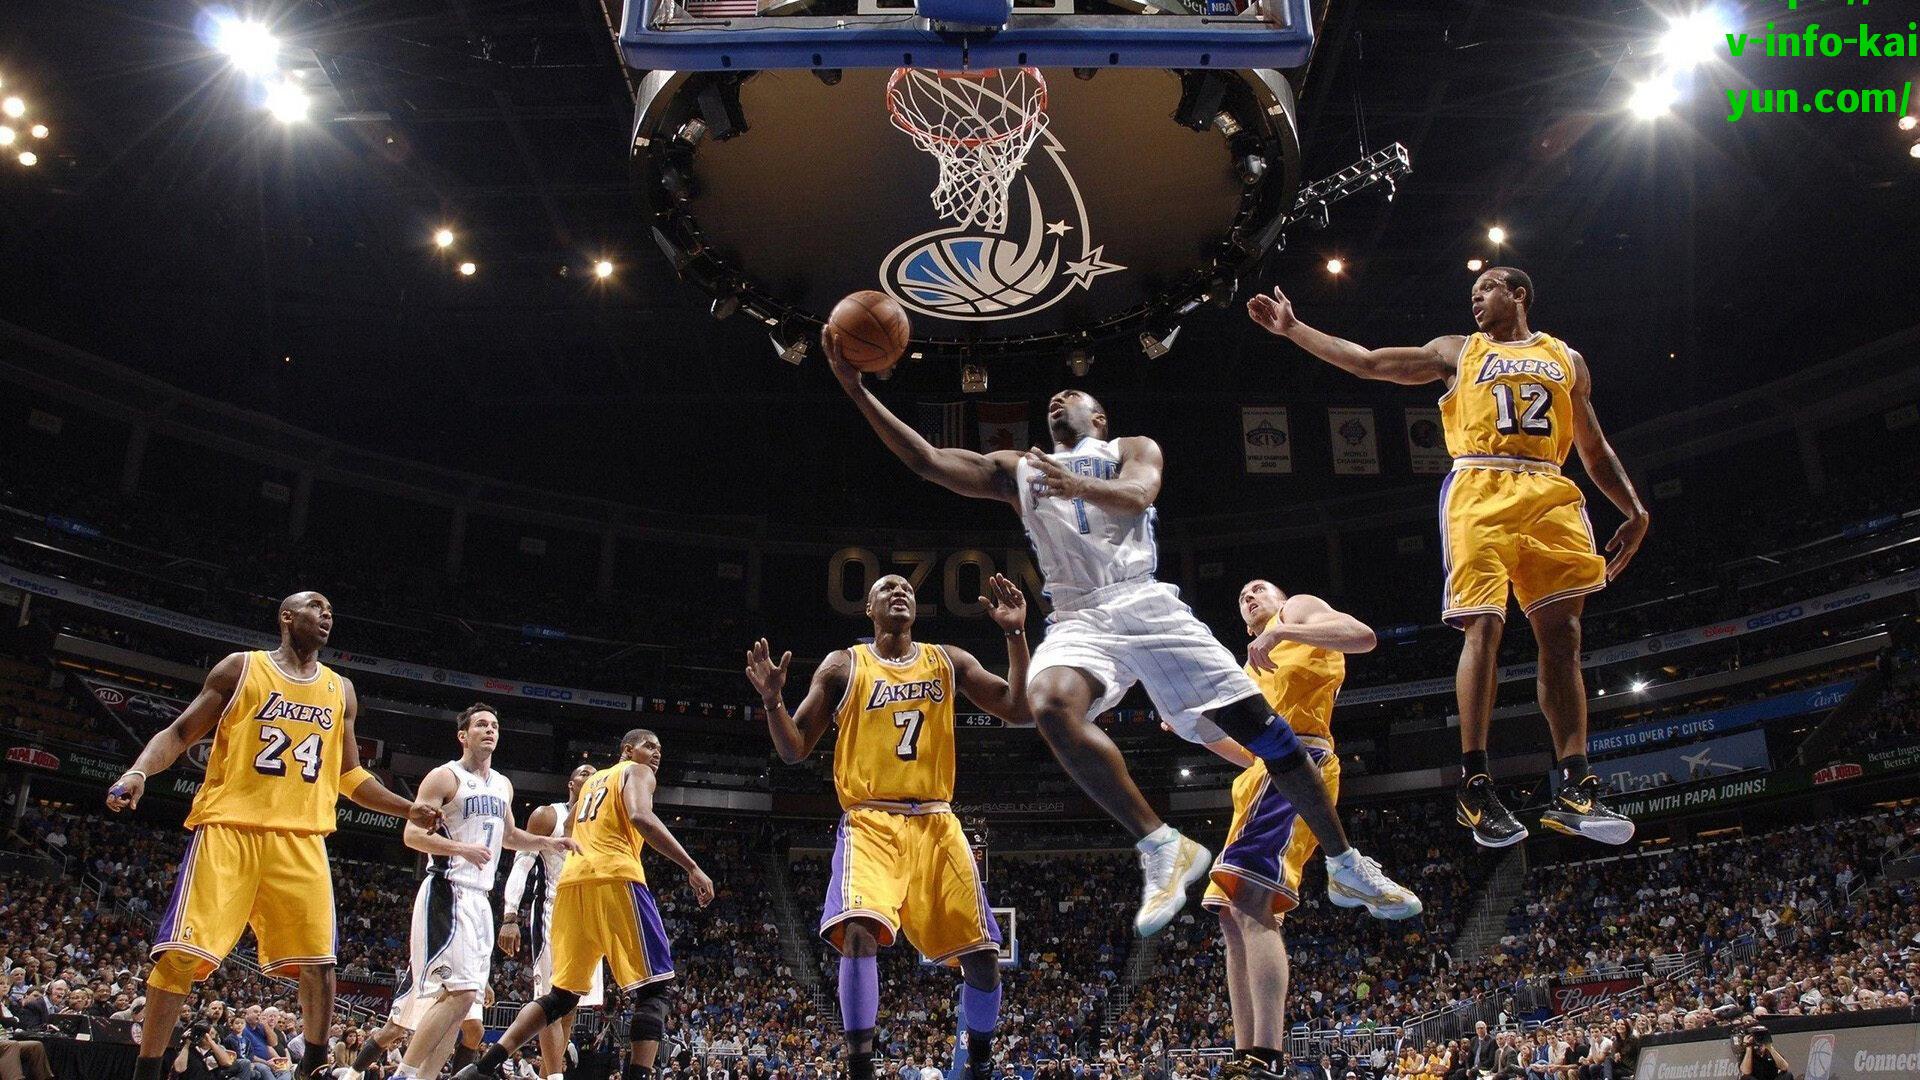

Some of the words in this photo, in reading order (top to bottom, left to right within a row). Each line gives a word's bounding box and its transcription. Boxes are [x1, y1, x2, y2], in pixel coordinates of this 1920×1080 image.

[1211, 2, 1232, 12] NBA
[1475, 353, 1565, 384] LAKERS
[1491, 383, 1553, 437] 12
[1071, 498, 1090, 534] 1
[10, 577, 58, 596] PEPSICO
[1823, 592, 1870, 610] PEPSICO
[1747, 606, 1803, 629] GEICO
[98, 690, 119, 702] KIA
[522, 685, 572, 701] GEICO
[588, 697, 627, 709] PEPSICO
[865, 679, 945, 711] LAKERS
[254, 691, 334, 731] LAKERS
[965, 715, 992, 726] 4:52
[894, 709, 925, 761] 7
[1593, 736, 1623, 752] FARES
[1625, 733, 1638, 746] TO
[1639, 728, 1666, 743] OVER
[1682, 719, 1715, 734] CITIES
[69, 752, 96, 766] Better
[254, 725, 324, 784] 24
[1867, 748, 1895, 762] Better
[1883, 756, 1912, 769] Better
[81, 765, 107, 778] Better
[577, 787, 608, 823] 17
[983, 801, 1036, 812] BASELINE
[1040, 800, 1064, 811] BAR
[1618, 800, 1645, 817] WIN
[1648, 796, 1681, 813] WITH
[1684, 789, 1717, 806] PAPA
[1720, 777, 1767, 801] JOHNS!
[336, 808, 352, 823] PA
[355, 811, 399, 829] JOHNS!
[483, 821, 495, 848] 7
[1658, 1060, 1698, 1079] Connect
[1700, 1059, 1712, 1077] at
